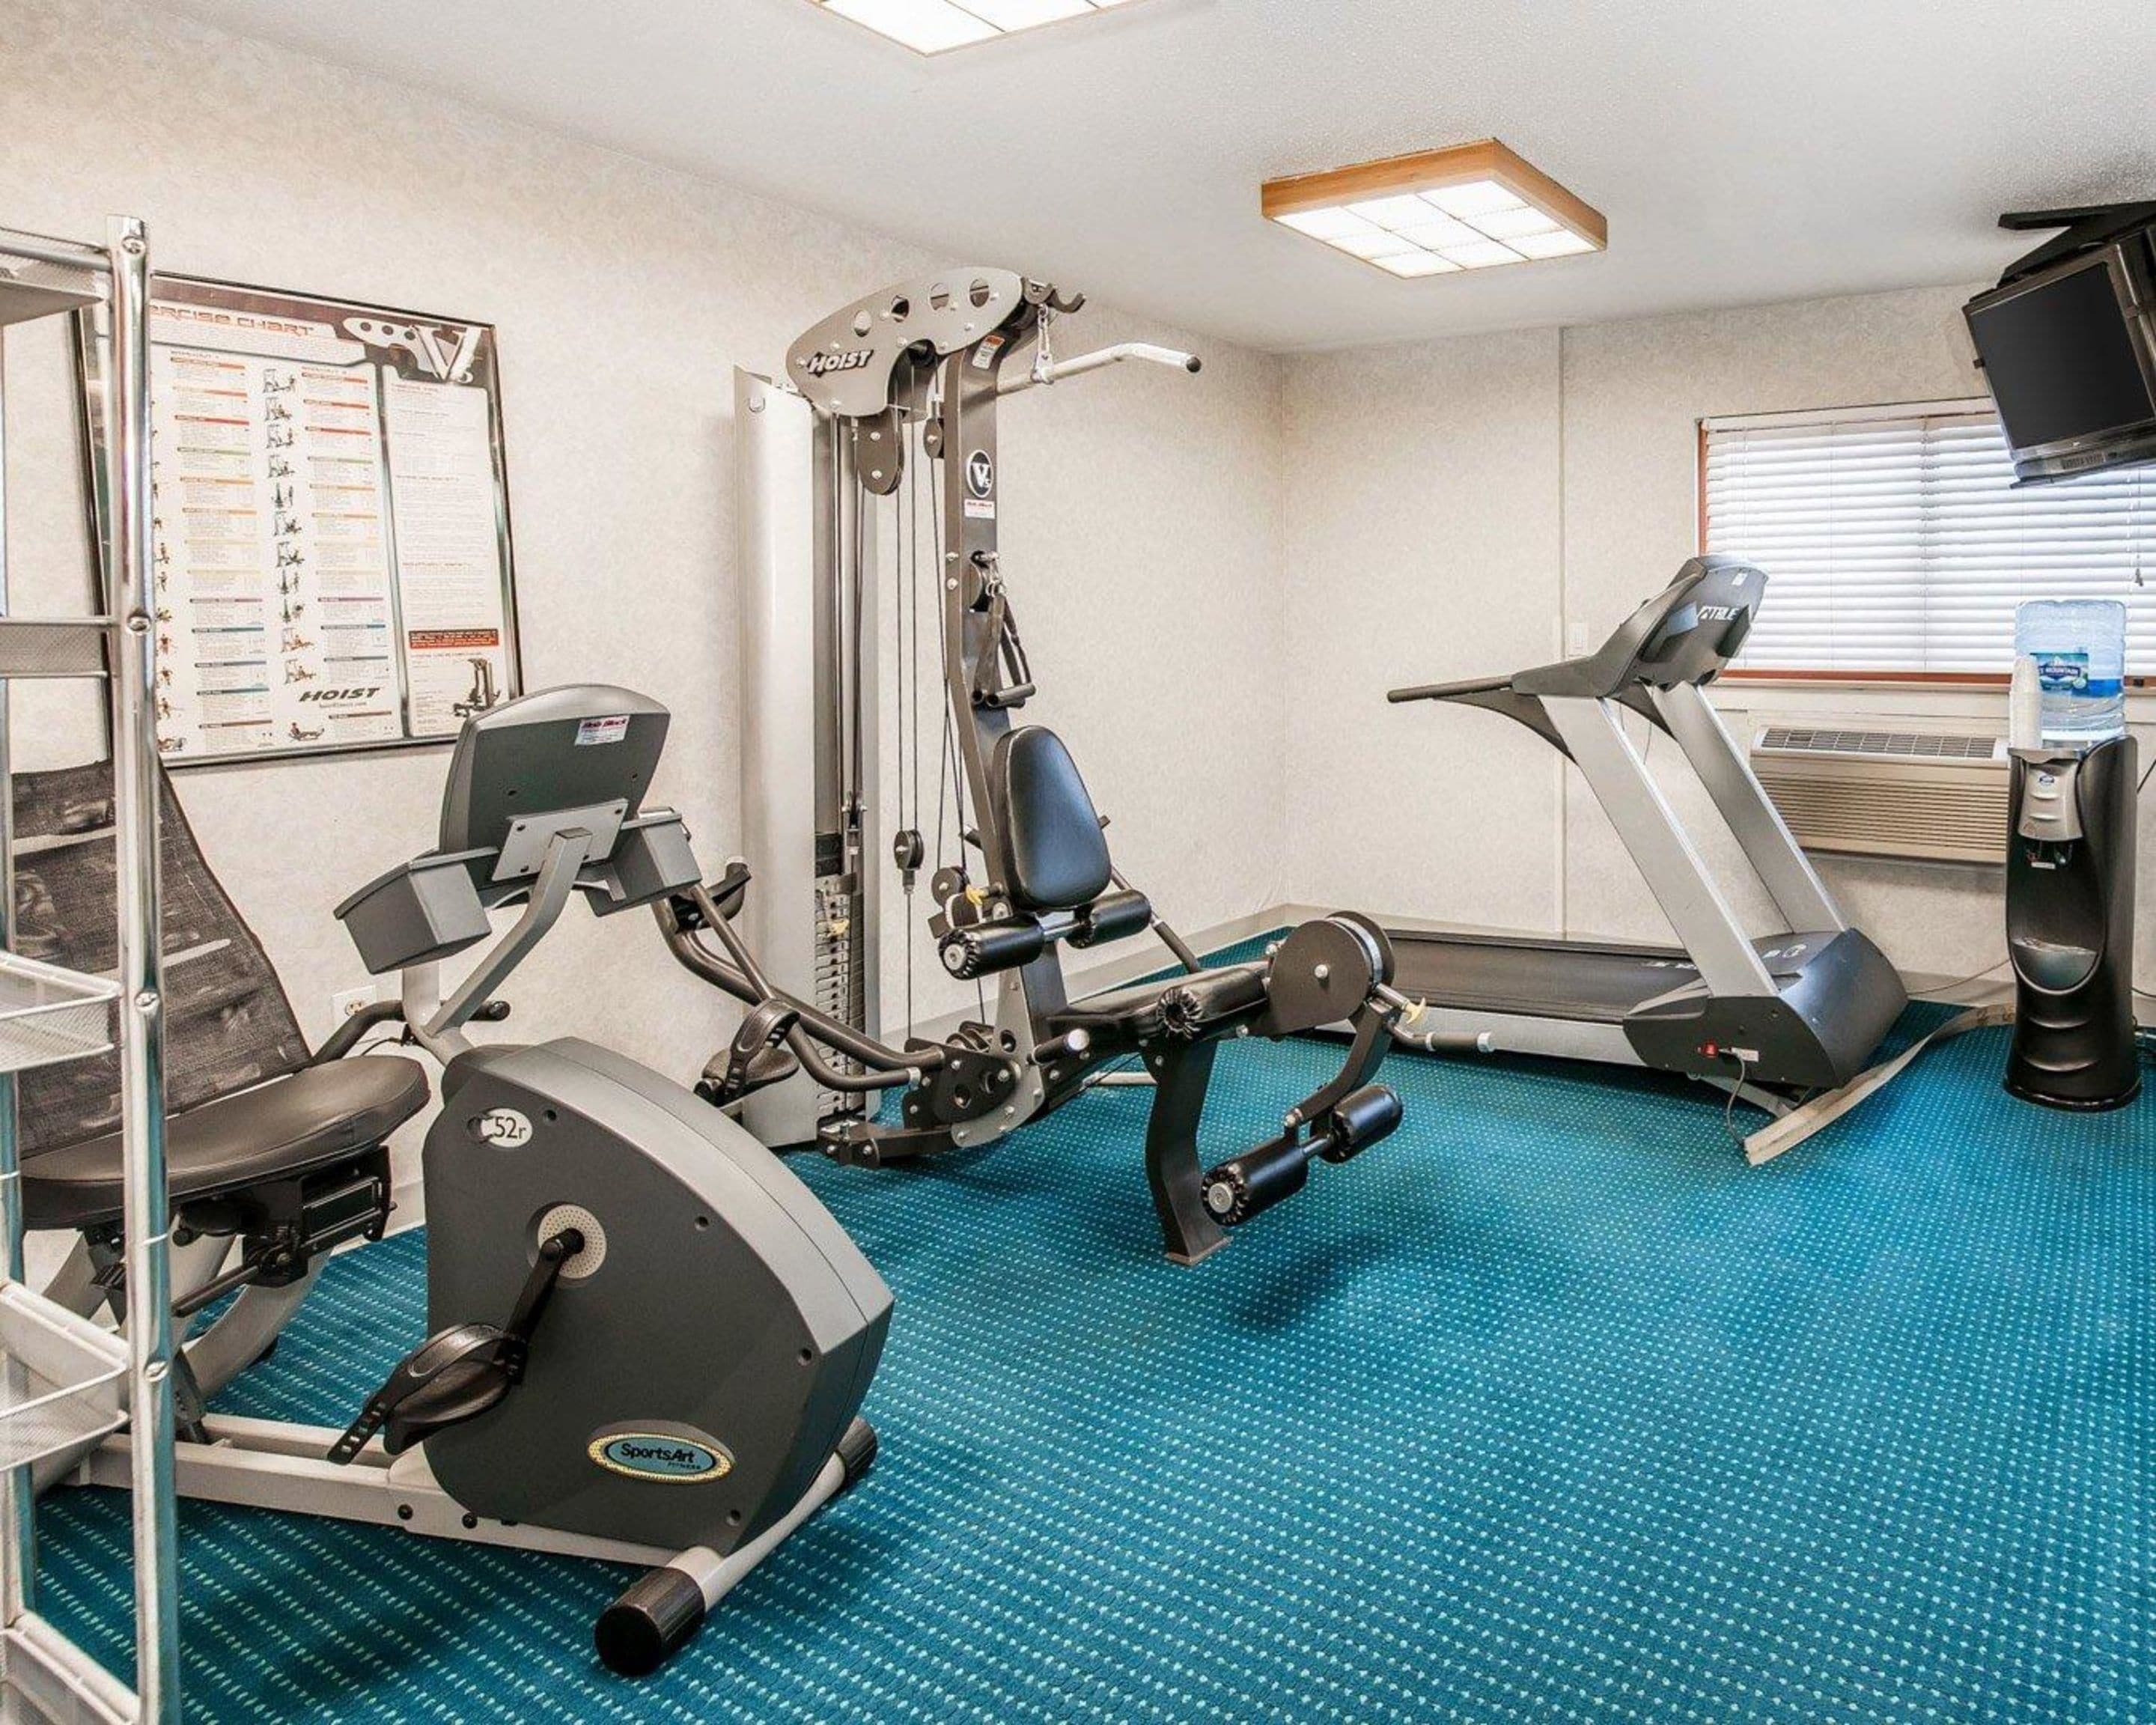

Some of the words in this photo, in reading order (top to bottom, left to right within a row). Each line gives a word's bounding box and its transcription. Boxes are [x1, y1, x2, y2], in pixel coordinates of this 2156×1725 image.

[808, 350, 873, 375] HOIST
[299, 687, 380, 702] HOIST
[621, 1443, 695, 1461] SportsArt
